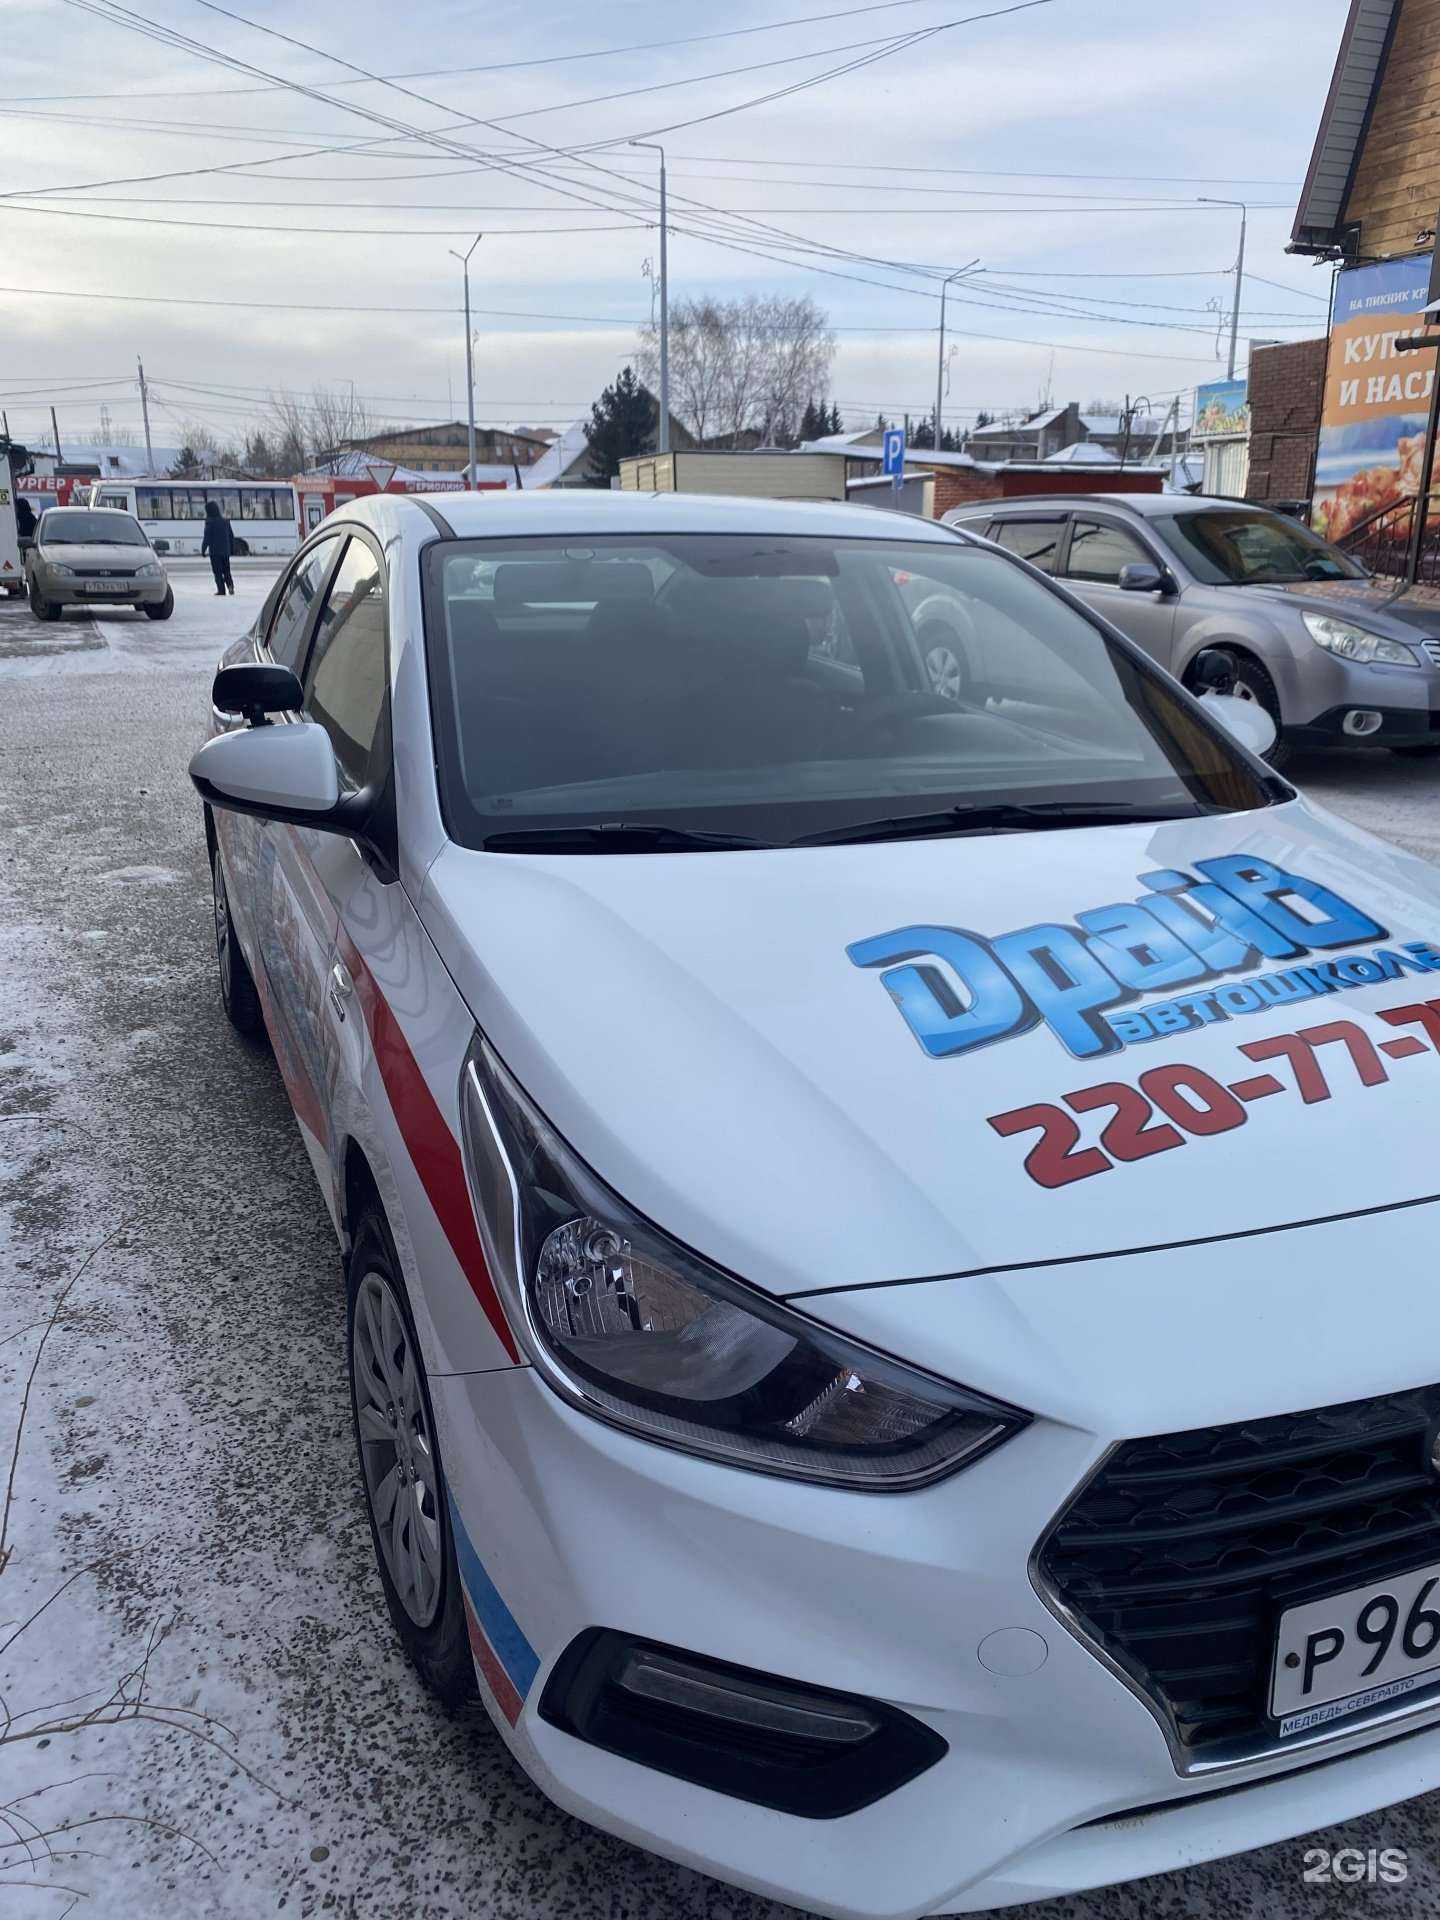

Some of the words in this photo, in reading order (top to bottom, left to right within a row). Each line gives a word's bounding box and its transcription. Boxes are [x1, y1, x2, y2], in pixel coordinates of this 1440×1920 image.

[1349, 299, 1363, 311] НА
[1365, 289, 1411, 309] ПИКНИК
[1412, 287, 1429, 300] КР
[1339, 378, 1360, 407] И
[889, 434, 901, 471] P
[16, 477, 66, 490] УРГЕР
[415, 481, 465, 493] ЕРМОЛИНО
[986, 998, 1440, 1189] 220-77-7
[1282, 1679, 1415, 1734] МЕДВЕДЬ-СЕВЕРАВТО
